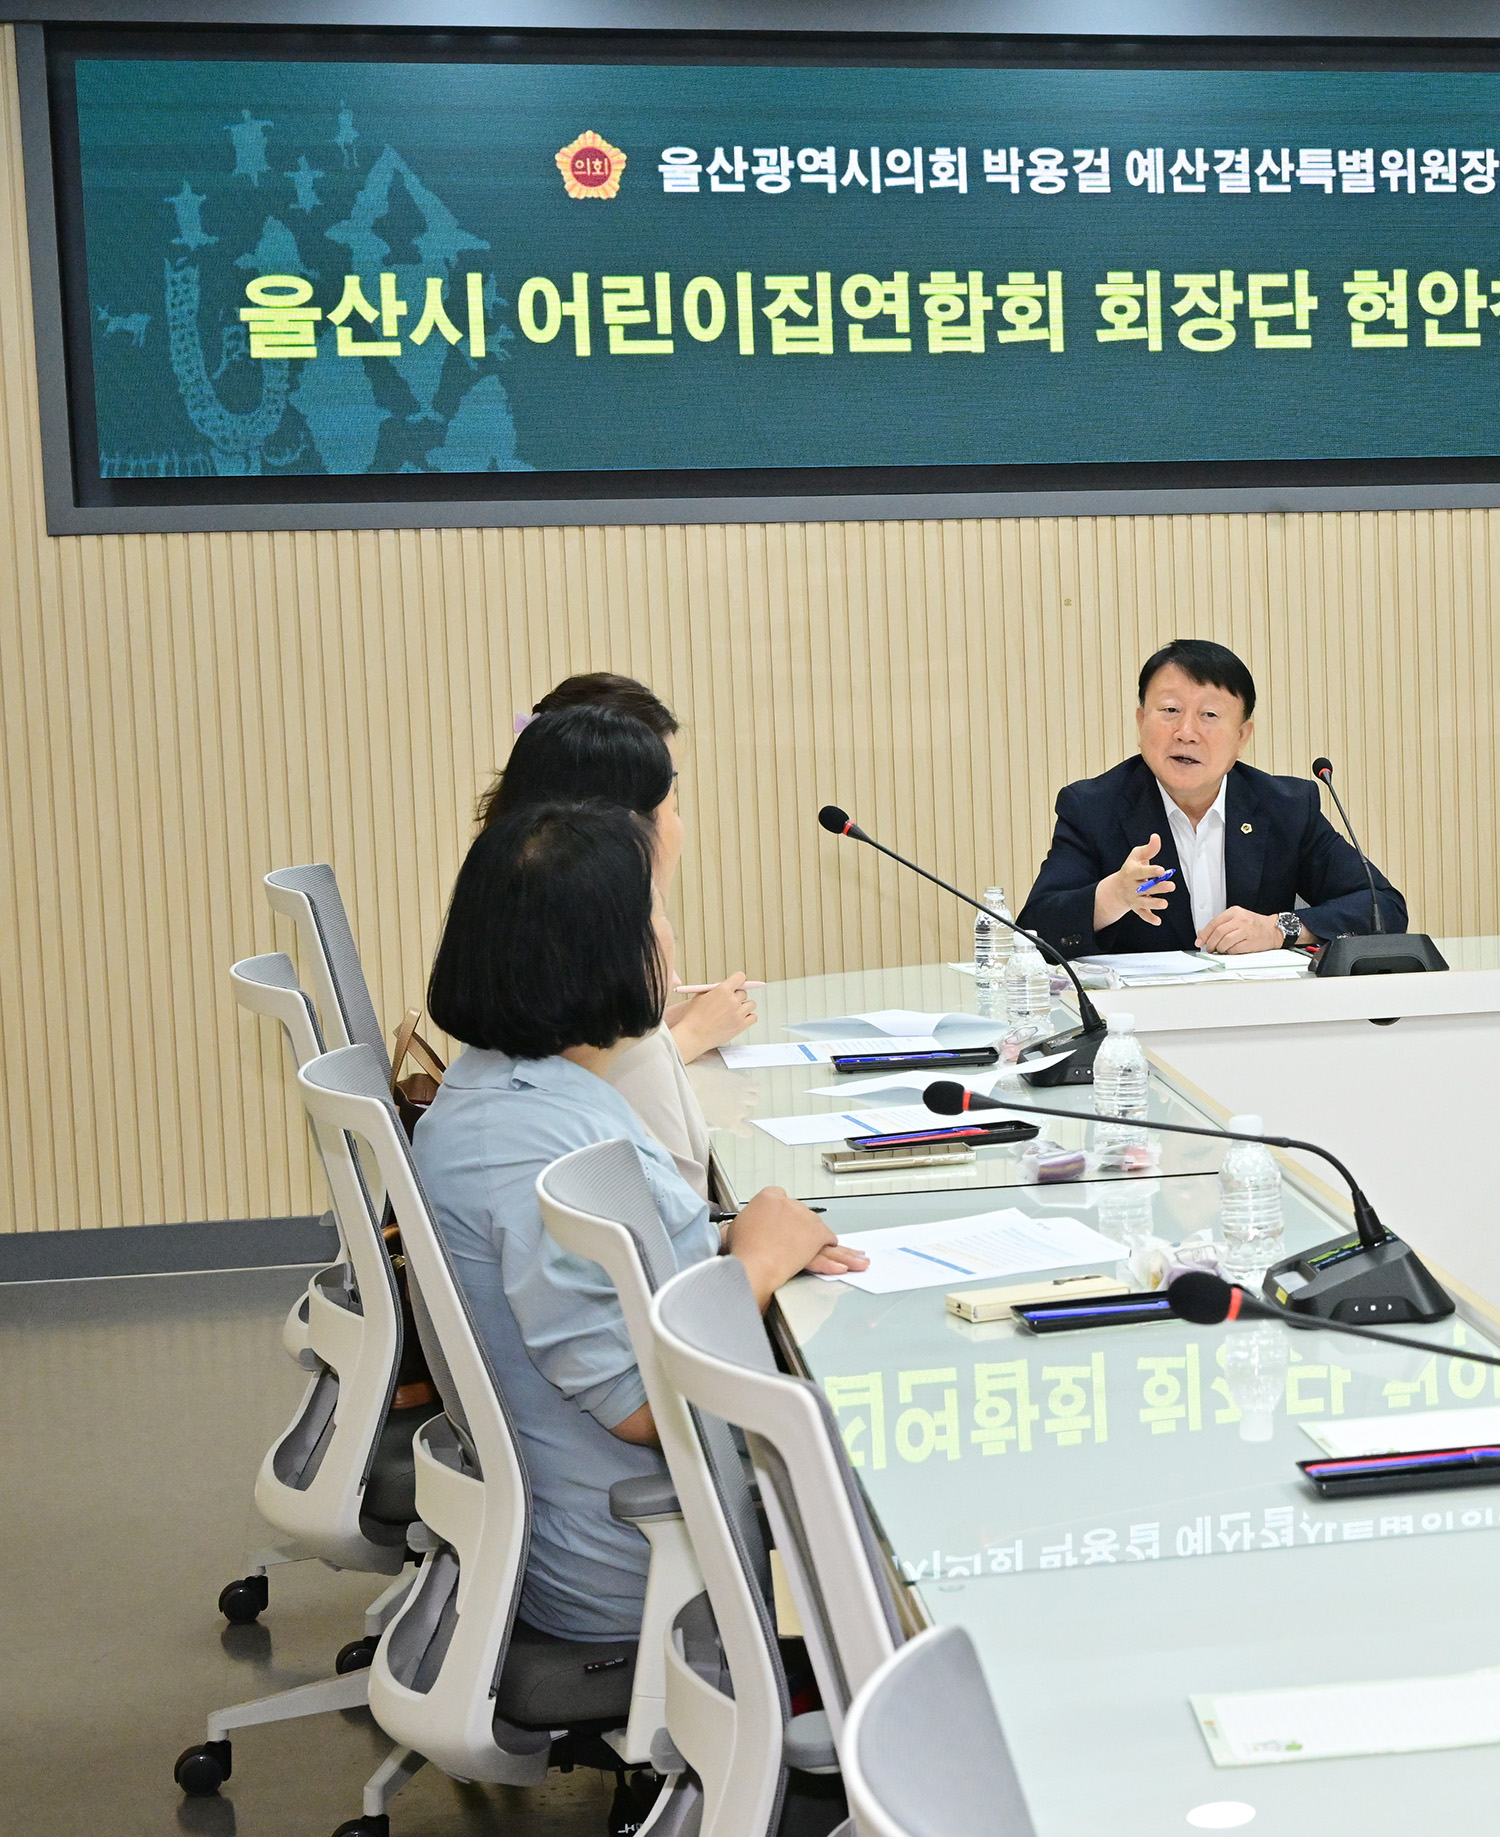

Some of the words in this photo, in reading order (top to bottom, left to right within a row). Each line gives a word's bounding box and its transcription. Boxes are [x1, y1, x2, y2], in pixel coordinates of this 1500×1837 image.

[574, 157, 609, 176] 의회
[658, 146, 968, 195] 울산광역시의회
[983, 147, 1111, 195] 박용걸
[1125, 147, 1500, 195] 예산결산특별위원장
[239, 272, 486, 359] 울산시
[517, 270, 1065, 357] 어린이집연합회
[1095, 269, 1319, 352] 회장단
